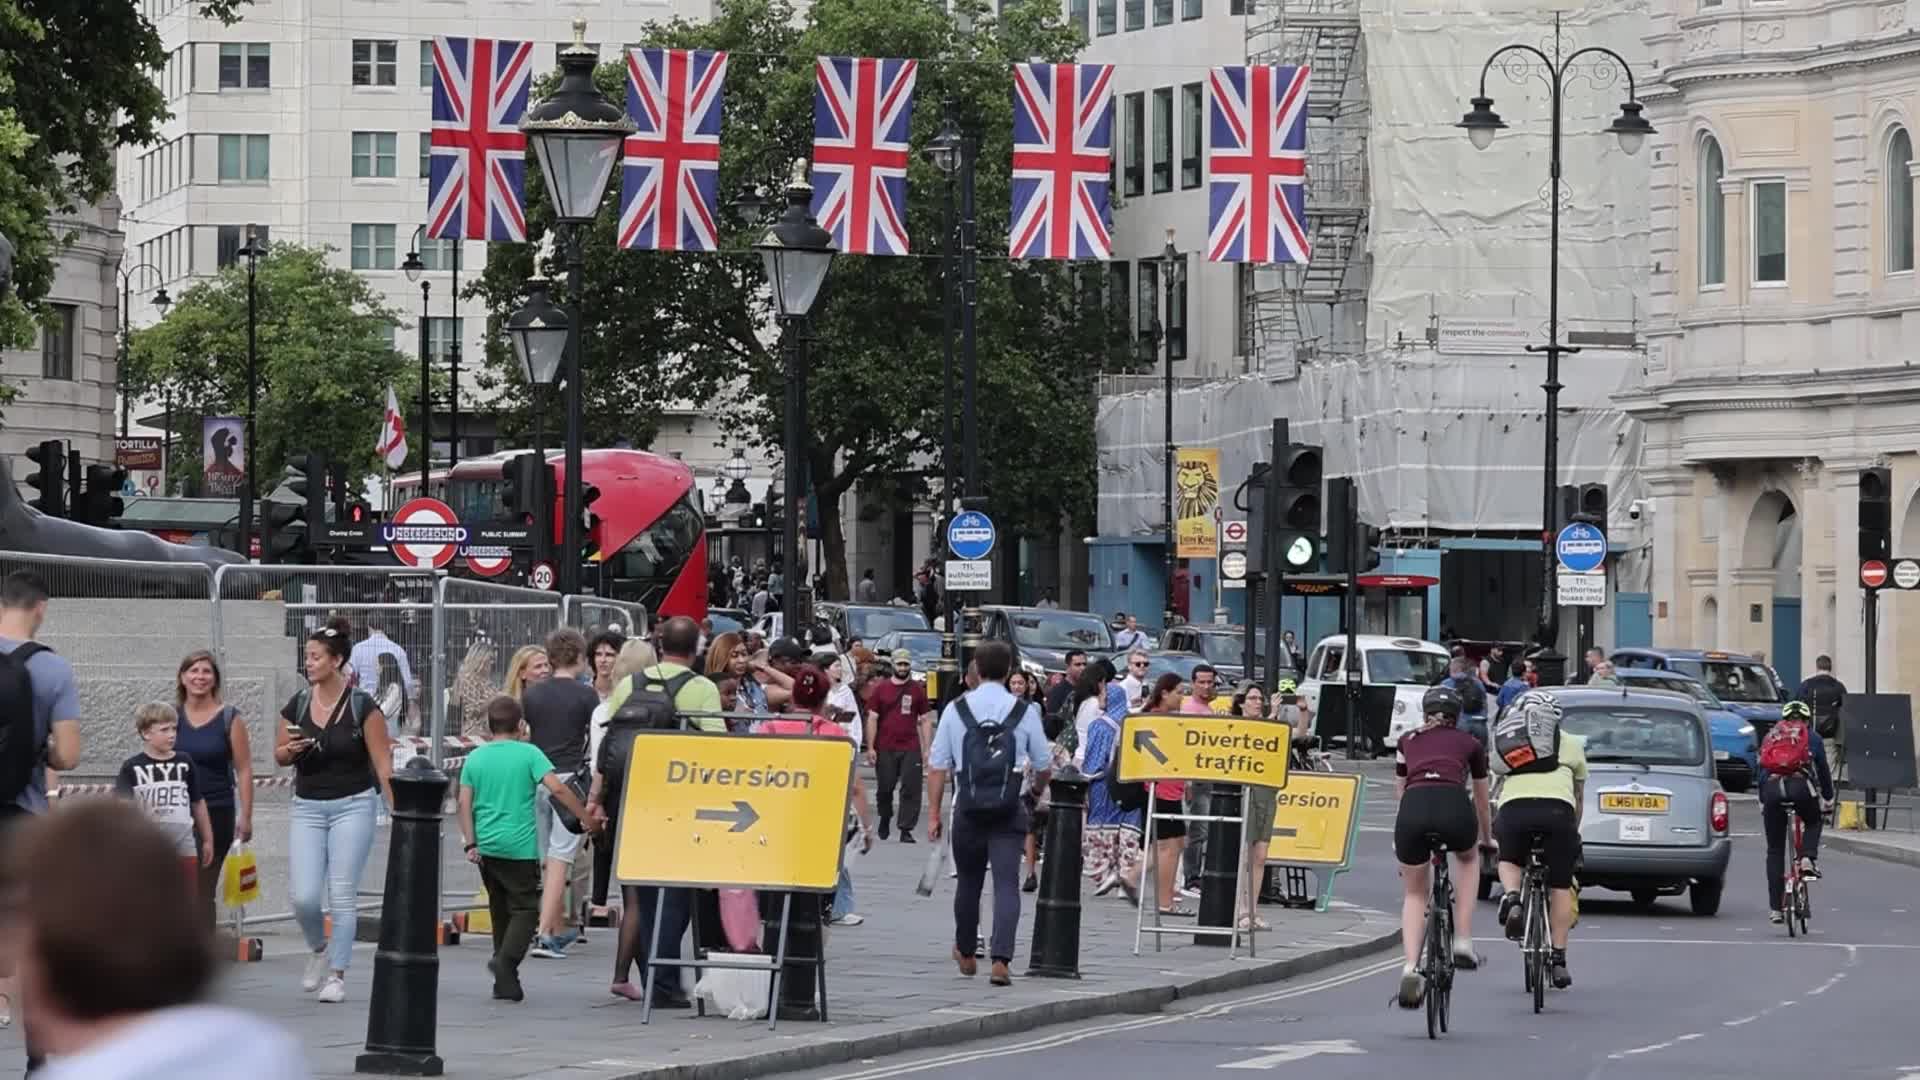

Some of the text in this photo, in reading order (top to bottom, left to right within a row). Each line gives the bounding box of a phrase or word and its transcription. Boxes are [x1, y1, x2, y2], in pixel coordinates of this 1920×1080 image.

[1472, 328, 1485, 337] the
[115, 440, 158, 449] TORTILLA
[383, 526, 467, 542] UNDERGROUND
[536, 571, 551, 583] 20
[1185, 730, 1279, 753] Diverted
[1195, 753, 1265, 774] traffic
[667, 760, 810, 789] Diversion
[139, 786, 189, 808] VIBES
[1278, 791, 1340, 809] ersion
